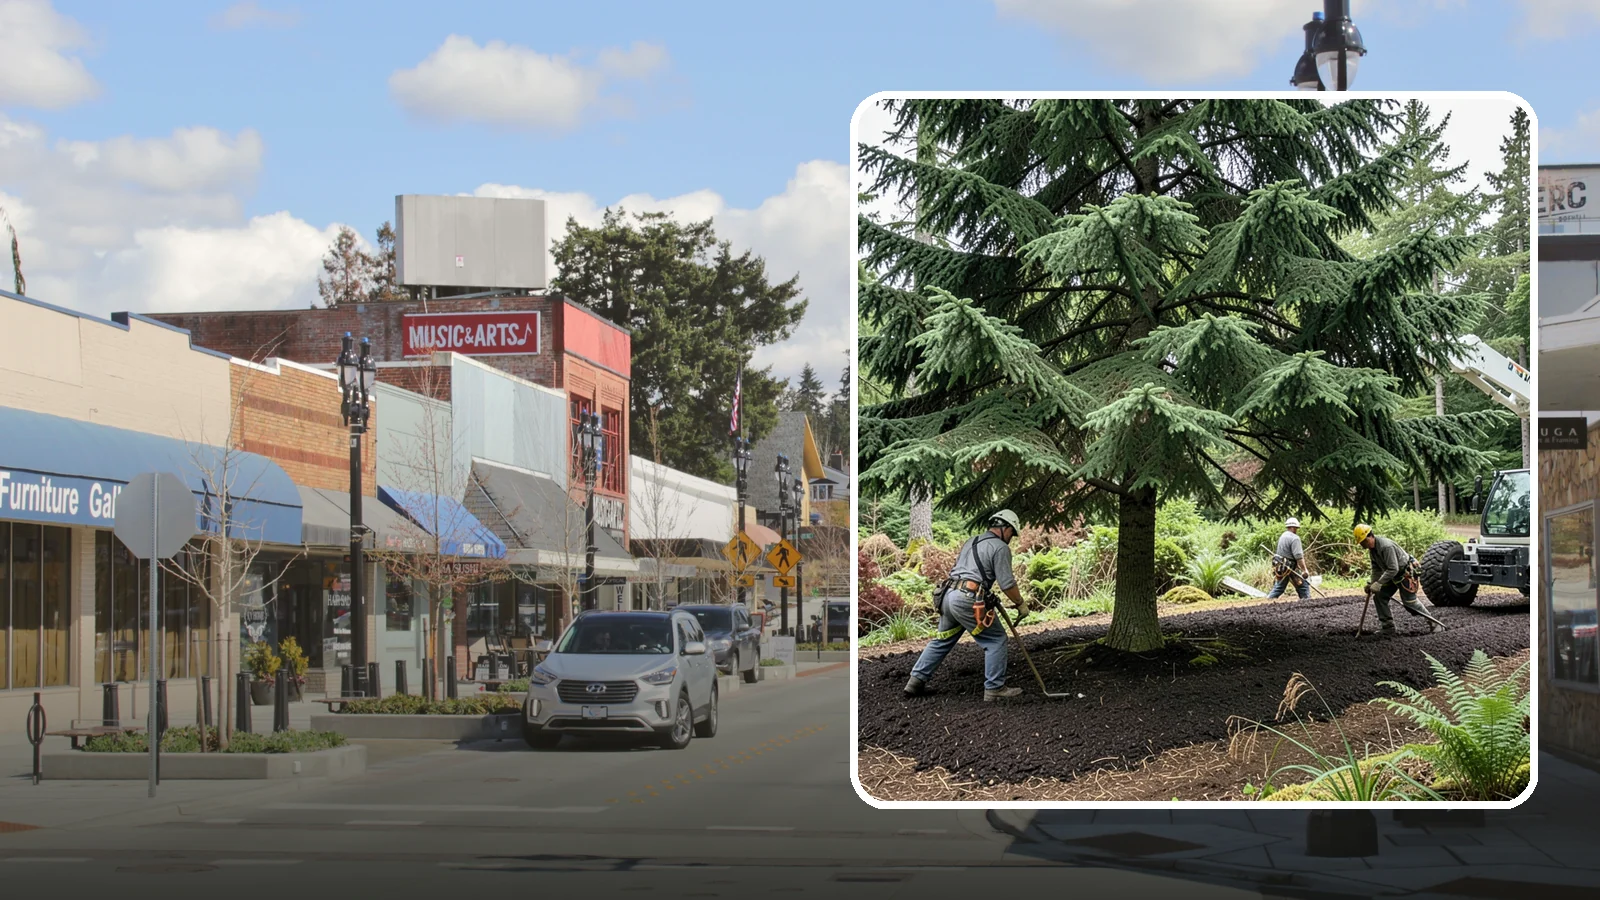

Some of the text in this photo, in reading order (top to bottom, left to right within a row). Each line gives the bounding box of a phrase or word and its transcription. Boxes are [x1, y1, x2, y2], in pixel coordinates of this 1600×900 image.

[1540, 427, 1577, 436] UGA
[0, 471, 121, 519] Furniture Gal
